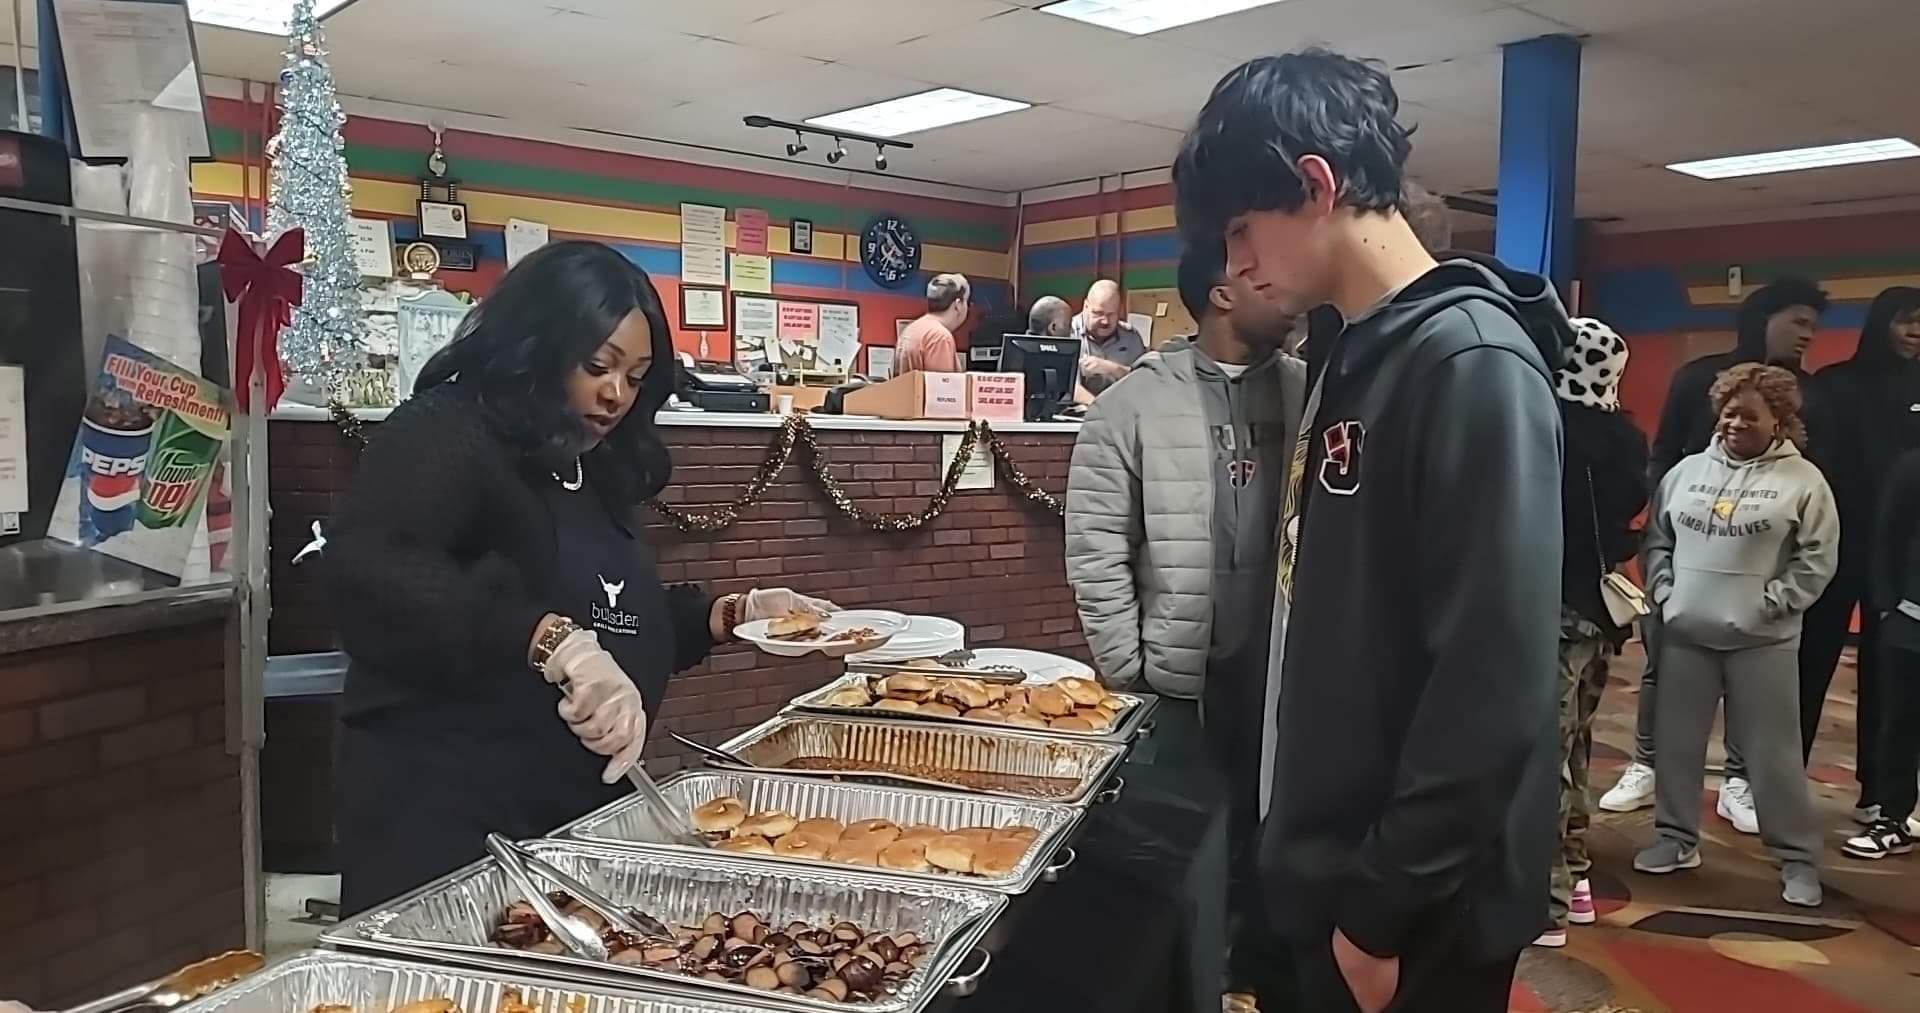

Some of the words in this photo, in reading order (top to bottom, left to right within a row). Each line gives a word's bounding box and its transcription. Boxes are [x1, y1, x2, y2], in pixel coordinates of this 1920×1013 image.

[887, 219, 898, 231] 12
[868, 242, 876, 257] 9
[905, 246, 915, 257] 3
[888, 270, 897, 280] 6
[1039, 344, 1058, 352] DELL
[135, 365, 168, 388] Your
[169, 375, 197, 399] Cup
[82, 445, 146, 477] PEPS
